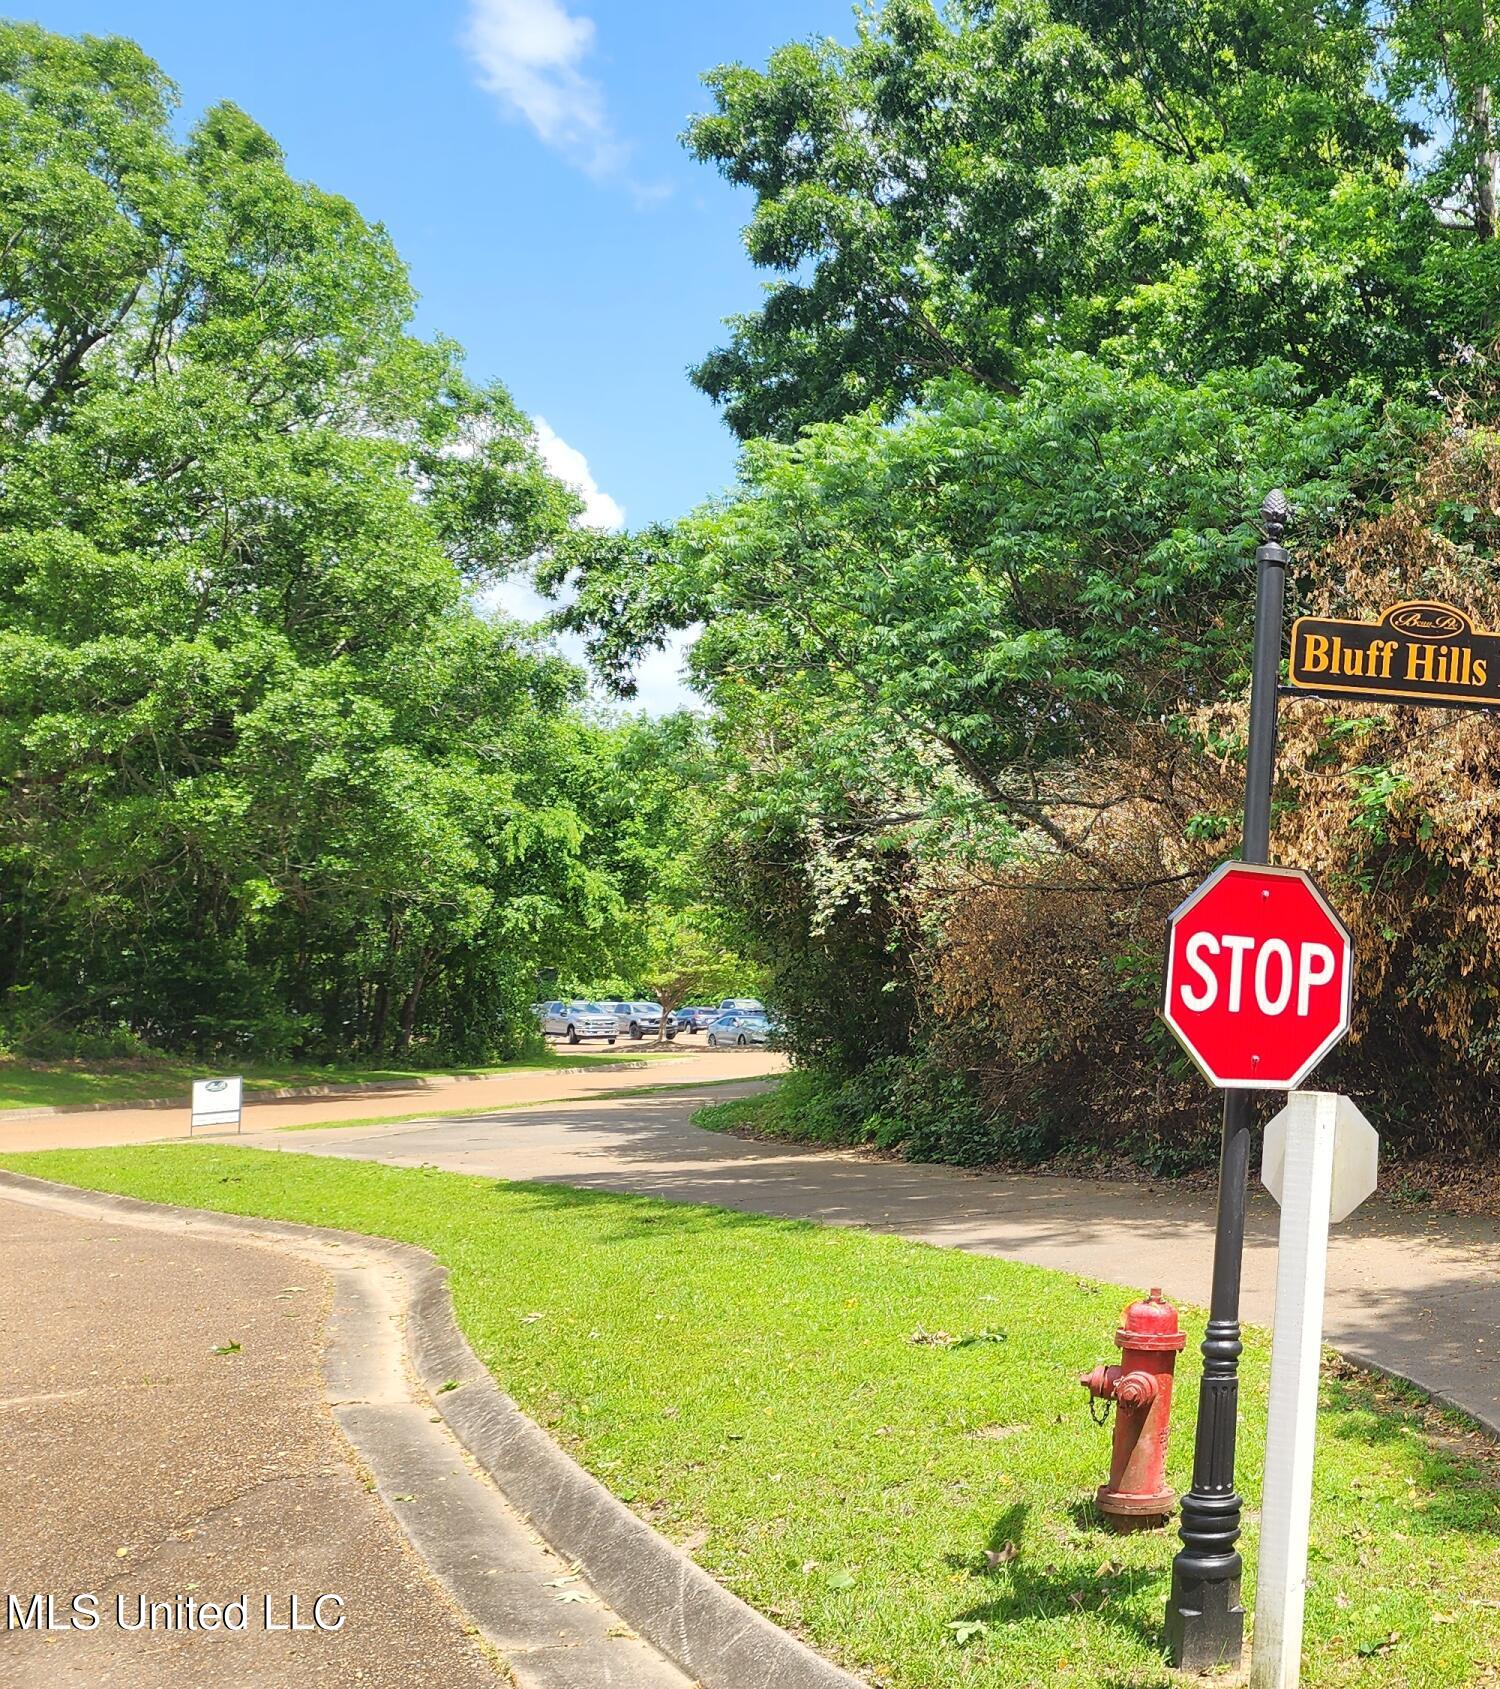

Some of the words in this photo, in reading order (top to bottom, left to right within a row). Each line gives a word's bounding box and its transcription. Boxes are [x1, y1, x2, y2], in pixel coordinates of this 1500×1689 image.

[1301, 634, 1398, 679] Bluff
[1403, 643, 1488, 687] Hills
[1180, 931, 1335, 1017] STOP
